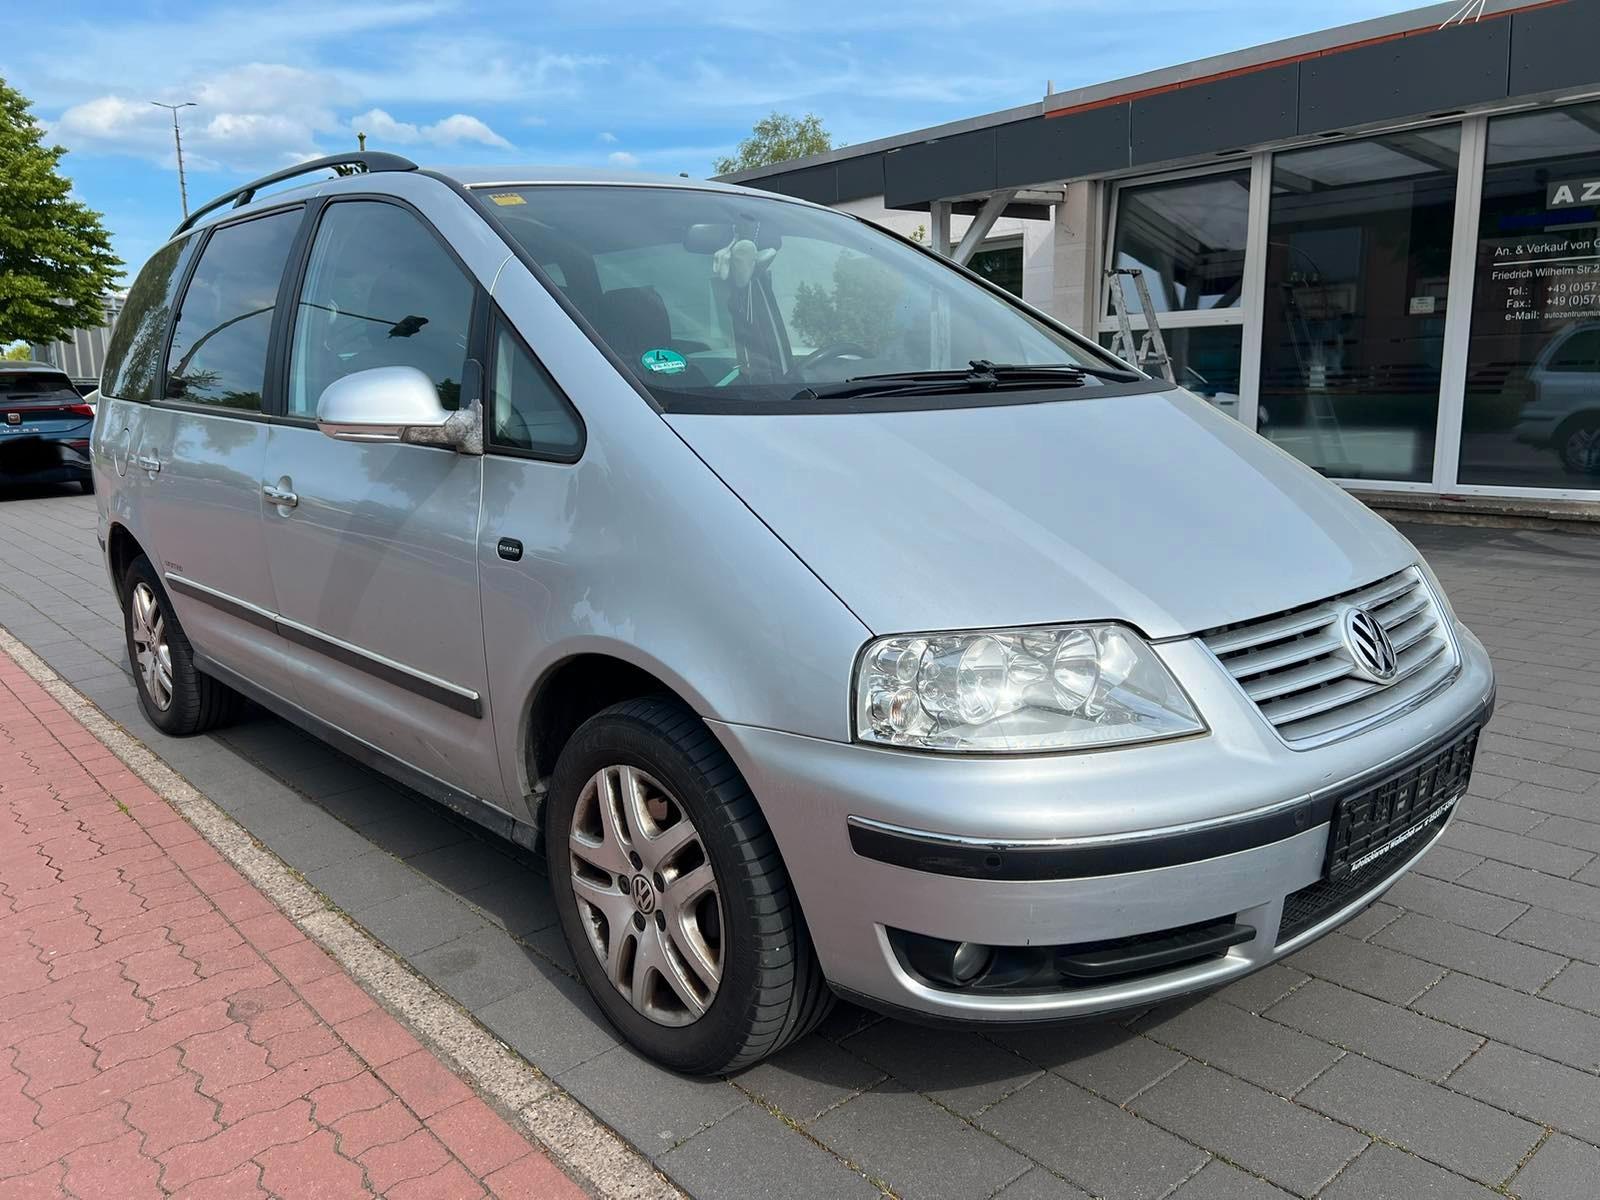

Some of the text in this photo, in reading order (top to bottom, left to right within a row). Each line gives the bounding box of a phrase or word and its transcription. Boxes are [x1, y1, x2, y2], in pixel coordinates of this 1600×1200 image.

[1494, 247, 1513, 257] An.
[1515, 245, 1524, 255] &
[1526, 241, 1568, 254] Verkauf
[1570, 240, 1590, 250] von
[1492, 269, 1533, 281] Friedrich
[1535, 266, 1574, 278] Wilhelm
[1547, 282, 1567, 294] +49
[1546, 295, 1566, 306] +49
[1505, 311, 1540, 321] e-Mail:
